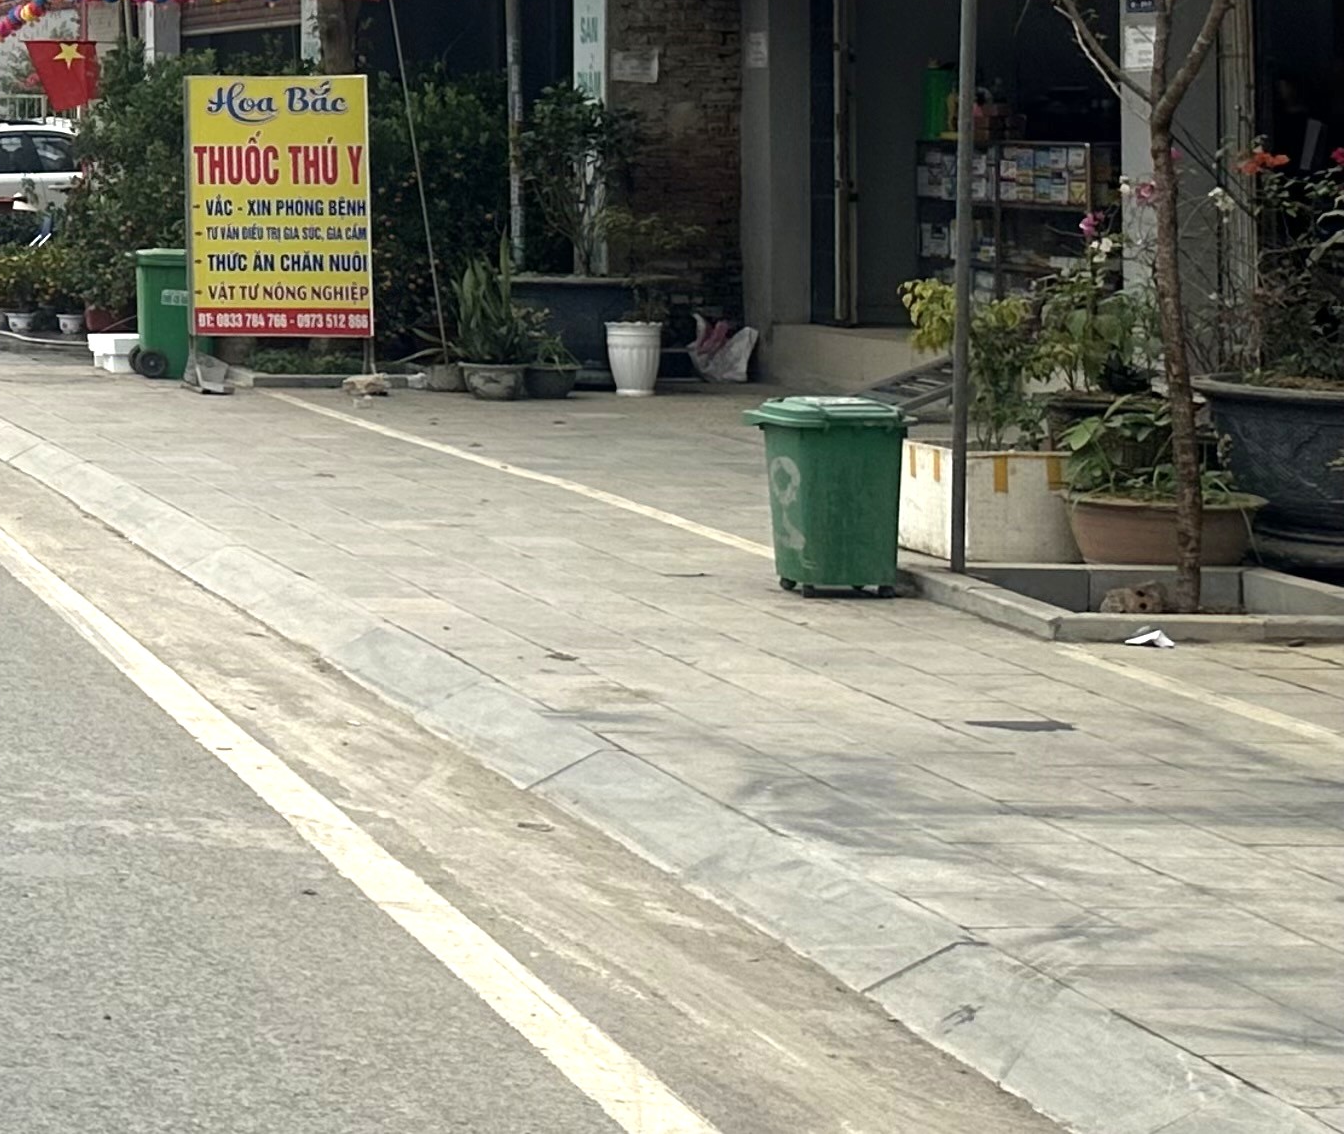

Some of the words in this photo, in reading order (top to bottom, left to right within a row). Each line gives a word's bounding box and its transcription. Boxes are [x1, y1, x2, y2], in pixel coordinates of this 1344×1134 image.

[207, 82, 278, 124] Hoa
[284, 80, 347, 113] Bắc
[193, 130, 280, 185] THUỐC
[288, 136, 338, 185] THÚ
[347, 145, 363, 185] Y
[248, 200, 271, 216] XIN
[207, 250, 248, 272] THỨC
[329, 251, 368, 272] NUÔI
[208, 281, 235, 304] VẬT
[239, 283, 259, 300] TƯ
[262, 281, 307, 301] NÔNG
[310, 281, 369, 305] NGHIỆP
